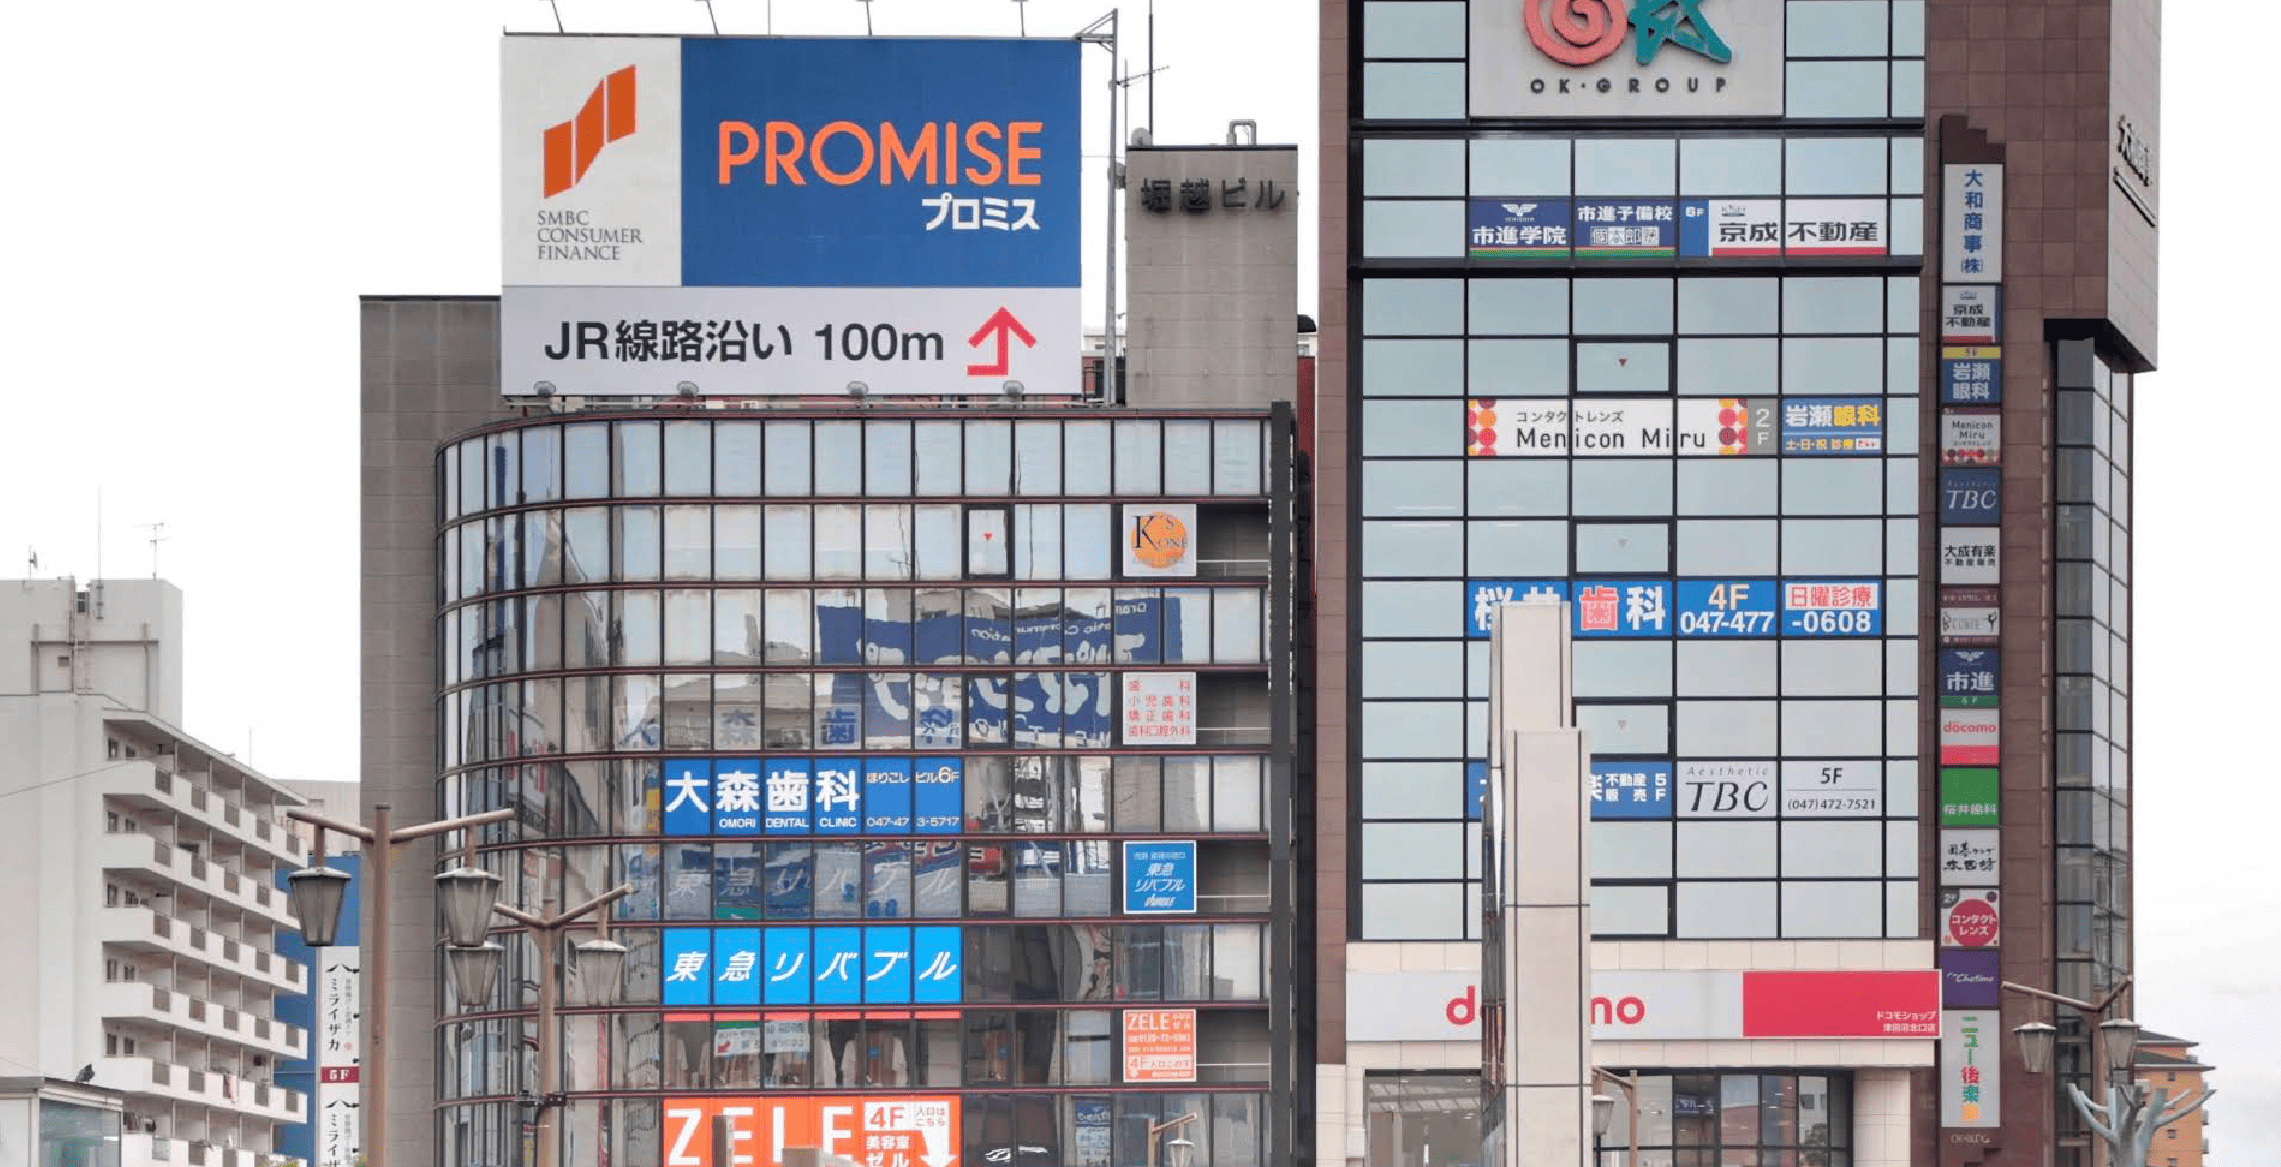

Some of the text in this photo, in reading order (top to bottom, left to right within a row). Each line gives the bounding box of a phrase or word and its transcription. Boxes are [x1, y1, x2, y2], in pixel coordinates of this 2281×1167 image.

[718, 121, 1044, 185] PROMISE
[538, 210, 588, 225] SMBC
[921, 192, 1040, 231] プロミス
[1577, 205, 1672, 221] 市進予備校
[537, 228, 643, 243] CONSUMER
[1472, 226, 1567, 244] 市進学院
[1719, 221, 1878, 242] 京成不動産
[538, 246, 621, 260] FINANCE
[1953, 304, 1984, 315] 京成
[1945, 316, 1991, 327] 不動産
[545, 321, 944, 362] JR線路沿い 100m
[1952, 362, 1991, 380] 岩瀬
[1952, 383, 1990, 399] 眼科
[1517, 410, 1625, 423] コンタクトレンズ
[1952, 421, 1994, 429] Menicon
[1516, 428, 1706, 448] Menicon Miru
[1959, 431, 1985, 440] Miru
[1945, 489, 1997, 509] TBC
[1708, 583, 1751, 611] 4F
[1790, 586, 1873, 608] 日曜診療
[1679, 611, 1775, 633] 047-477
[1791, 611, 1871, 633] -0608
[1946, 671, 1995, 691] 市進
[1943, 720, 1998, 732] docomo
[1687, 766, 1768, 776] Aesthetic
[1820, 767, 1843, 784] 5F
[665, 770, 860, 813] 大森歯科
[1685, 781, 1769, 812] TBC
[718, 818, 857, 828] OMORI DENTAL CLINIC
[1950, 915, 1997, 924] コンタクト
[1958, 926, 1989, 936] レンズ
[667, 950, 958, 981] 東急リバブル
[1128, 1012, 1171, 1031] ZELE
[1876, 1010, 1937, 1021] ドコモショップ
[869, 1106, 904, 1127] 4F
